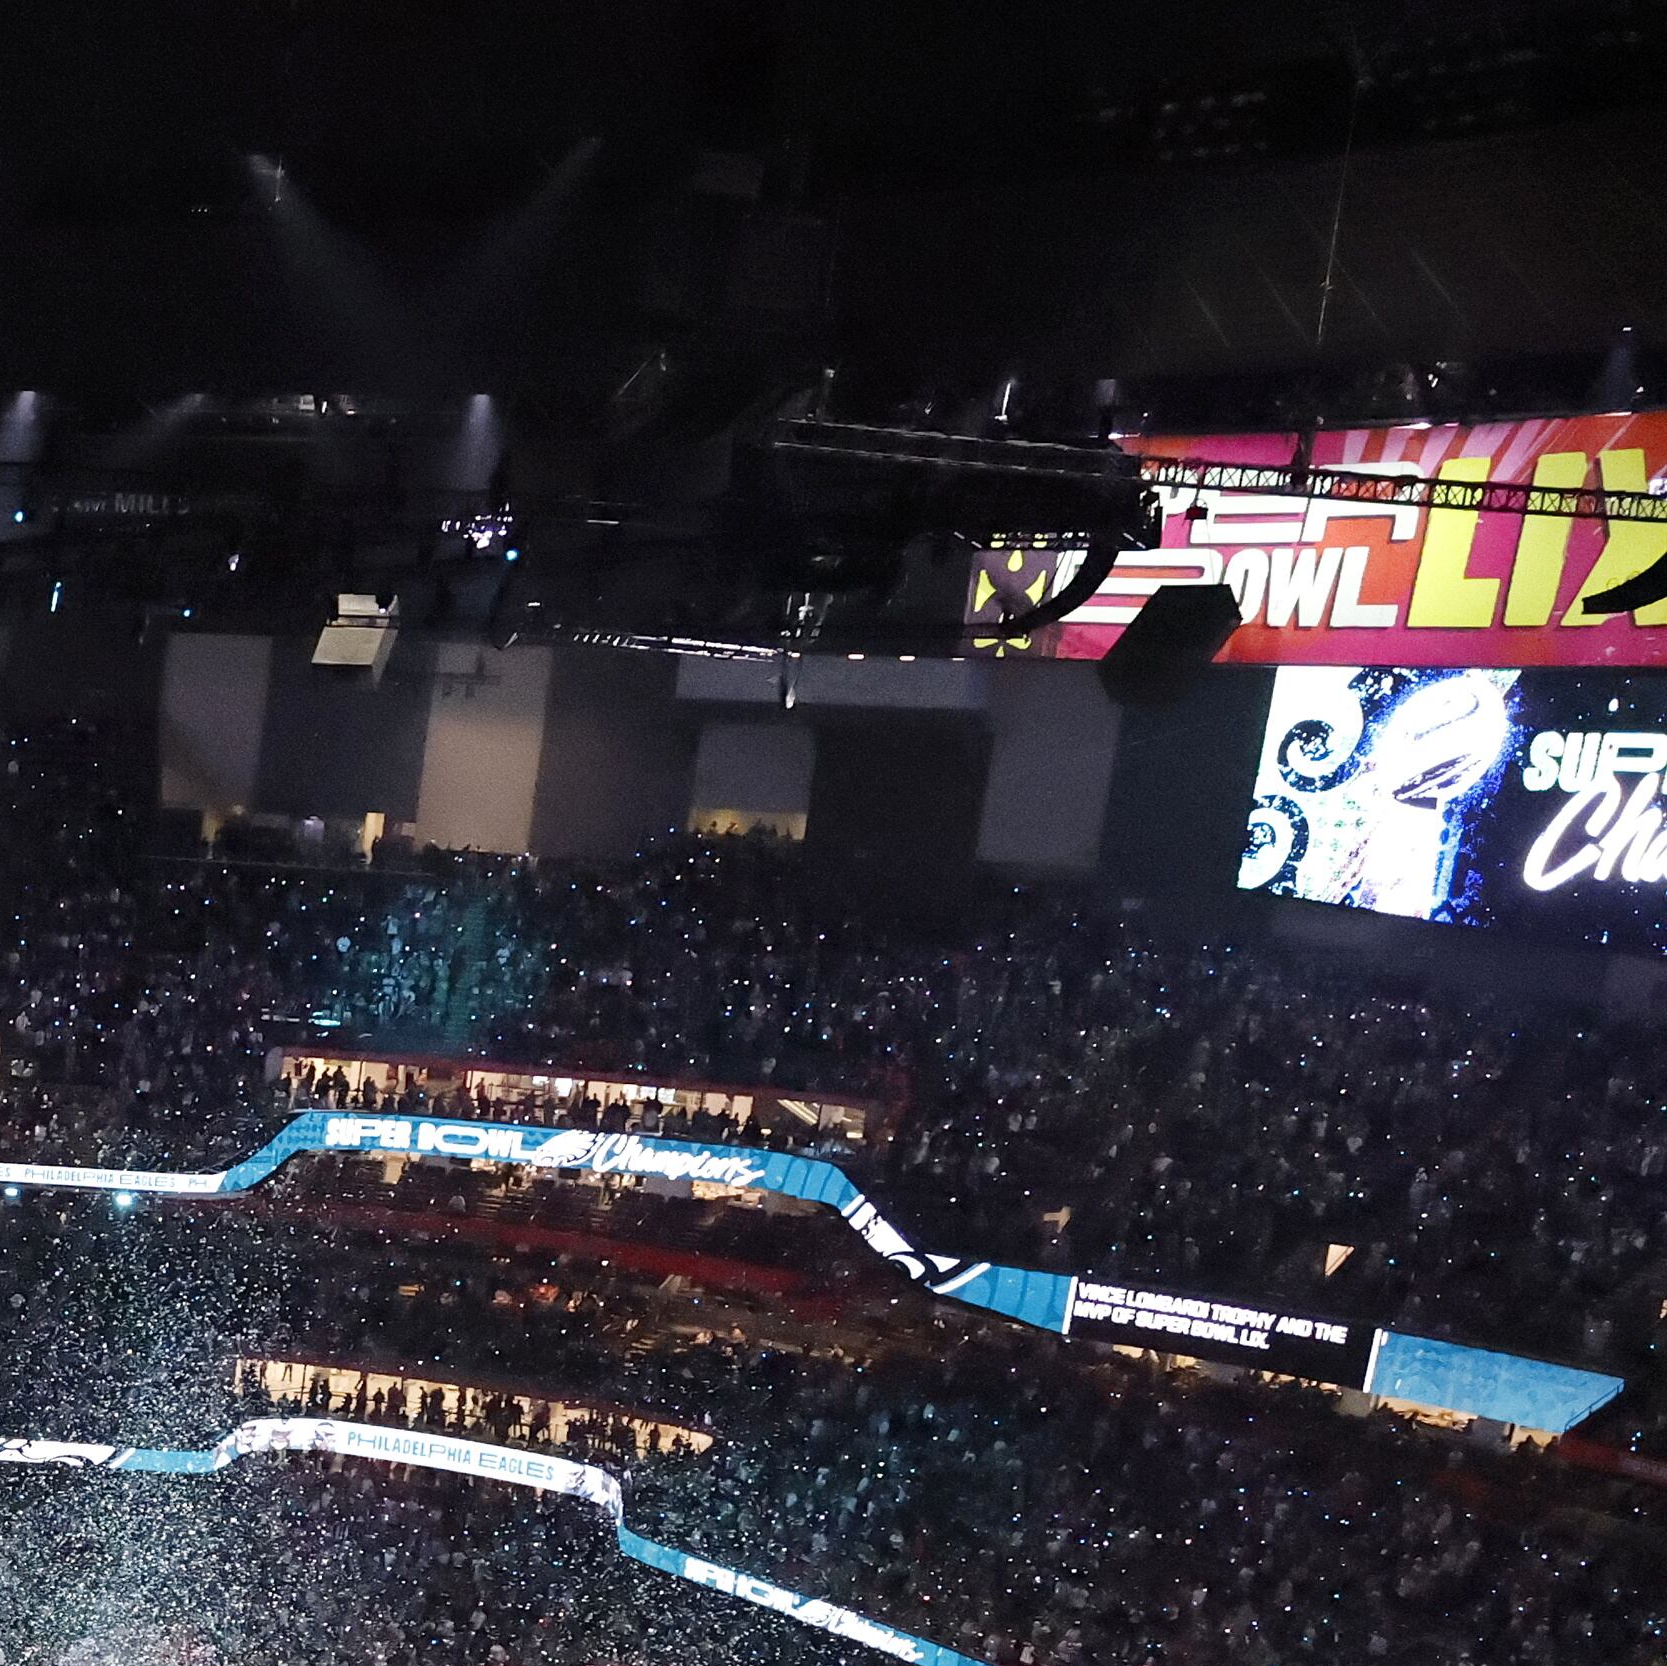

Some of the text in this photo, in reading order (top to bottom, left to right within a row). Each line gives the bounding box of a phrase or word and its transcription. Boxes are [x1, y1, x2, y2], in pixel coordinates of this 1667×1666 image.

[1522, 730, 1667, 794] SUP
[326, 1117, 768, 1184] SUPER BOWL Champions
[1072, 1301, 1112, 1321] MVP
[1111, 1306, 1136, 1325] OF
[1135, 1311, 1191, 1335] SUPER
[1190, 1319, 1240, 1345] BOWL
[1078, 1282, 1349, 1345] VINCE LOMBARDI TROPHY AND THE
[347, 1431, 555, 1481] PHILADELPHIA EAGLES
